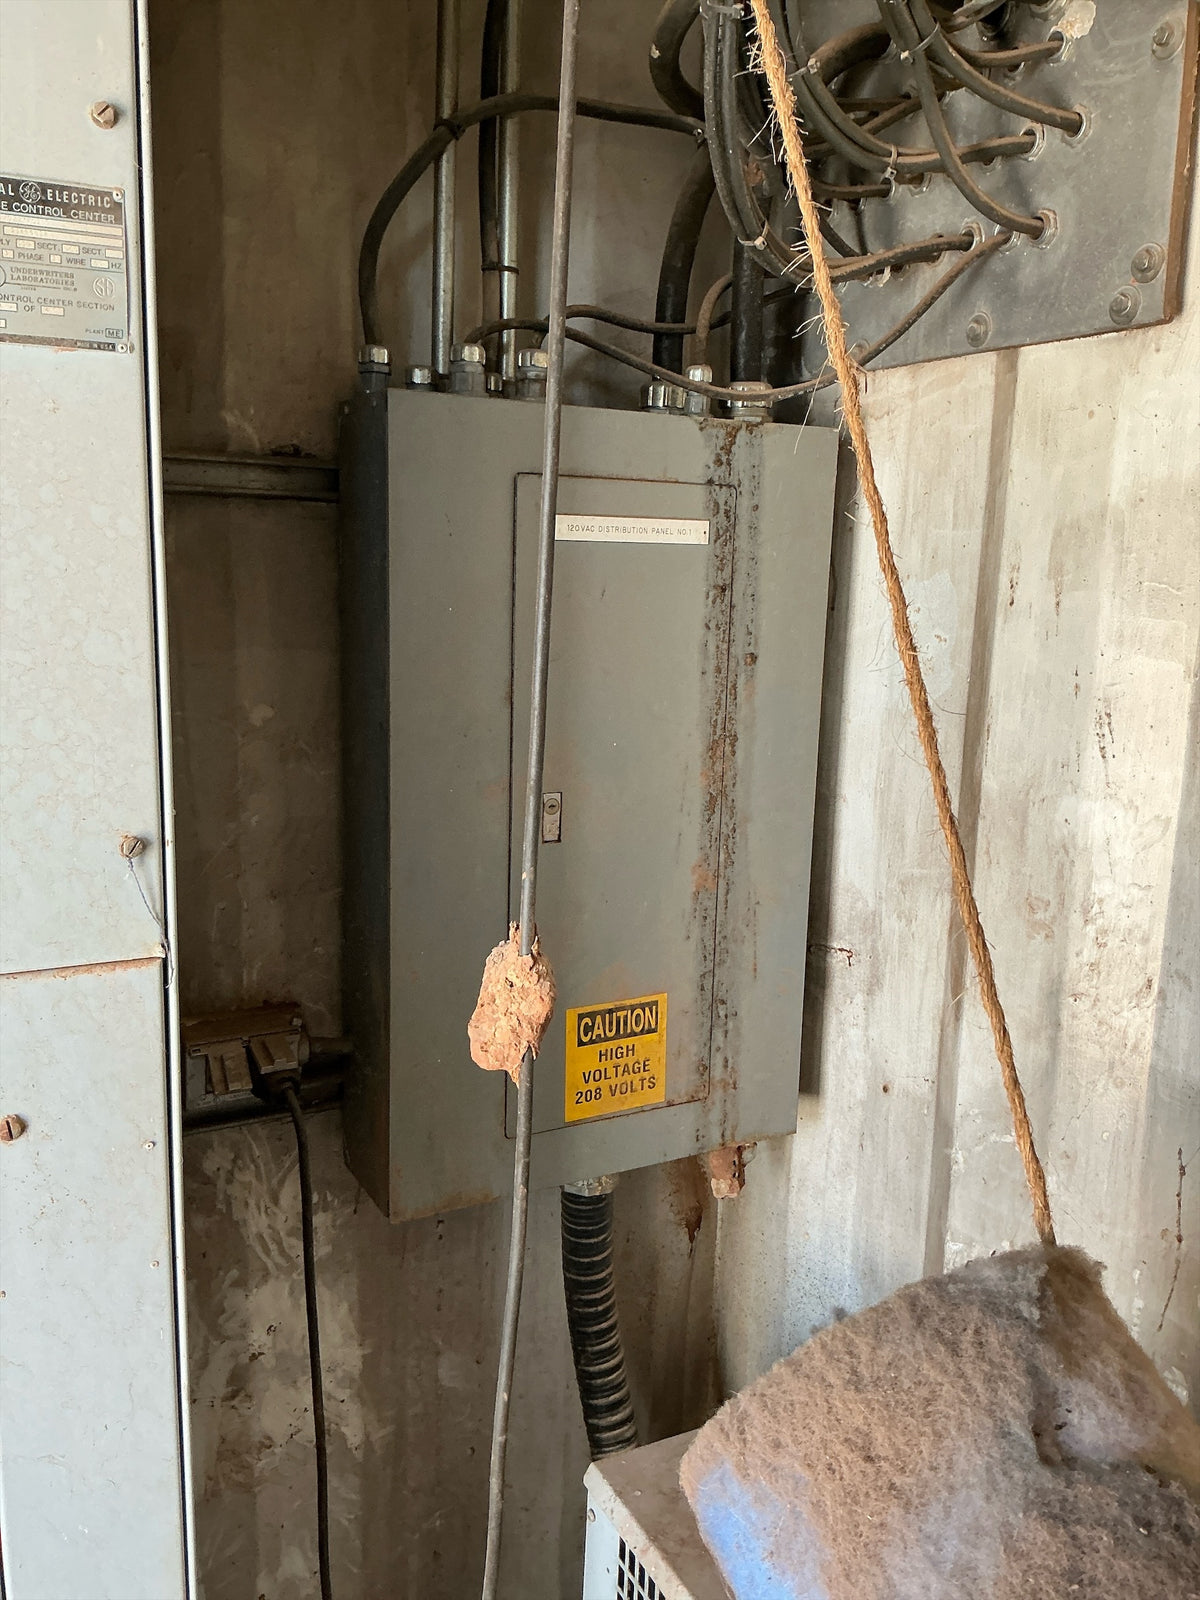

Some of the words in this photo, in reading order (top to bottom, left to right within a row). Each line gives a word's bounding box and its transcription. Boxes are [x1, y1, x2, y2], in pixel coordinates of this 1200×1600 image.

[47, 188, 111, 209] ELECTRIC
[1, 200, 9, 211] E
[12, 202, 67, 218] CONTROL
[70, 209, 115, 224] CENTER
[66, 257, 86, 266] WIRE
[23, 304, 36, 312] OF
[37, 297, 73, 307] CENTER
[76, 300, 115, 312] SECTION
[598, 525, 648, 535] DISTRIBUTION
[651, 527, 674, 536] PANEL
[579, 1005, 657, 1043] CAUTION
[598, 1043, 636, 1063] HIGH
[582, 1058, 651, 1085] VOLTAGE
[575, 1087, 602, 1105] 208
[608, 1075, 657, 1098] VOLTS
